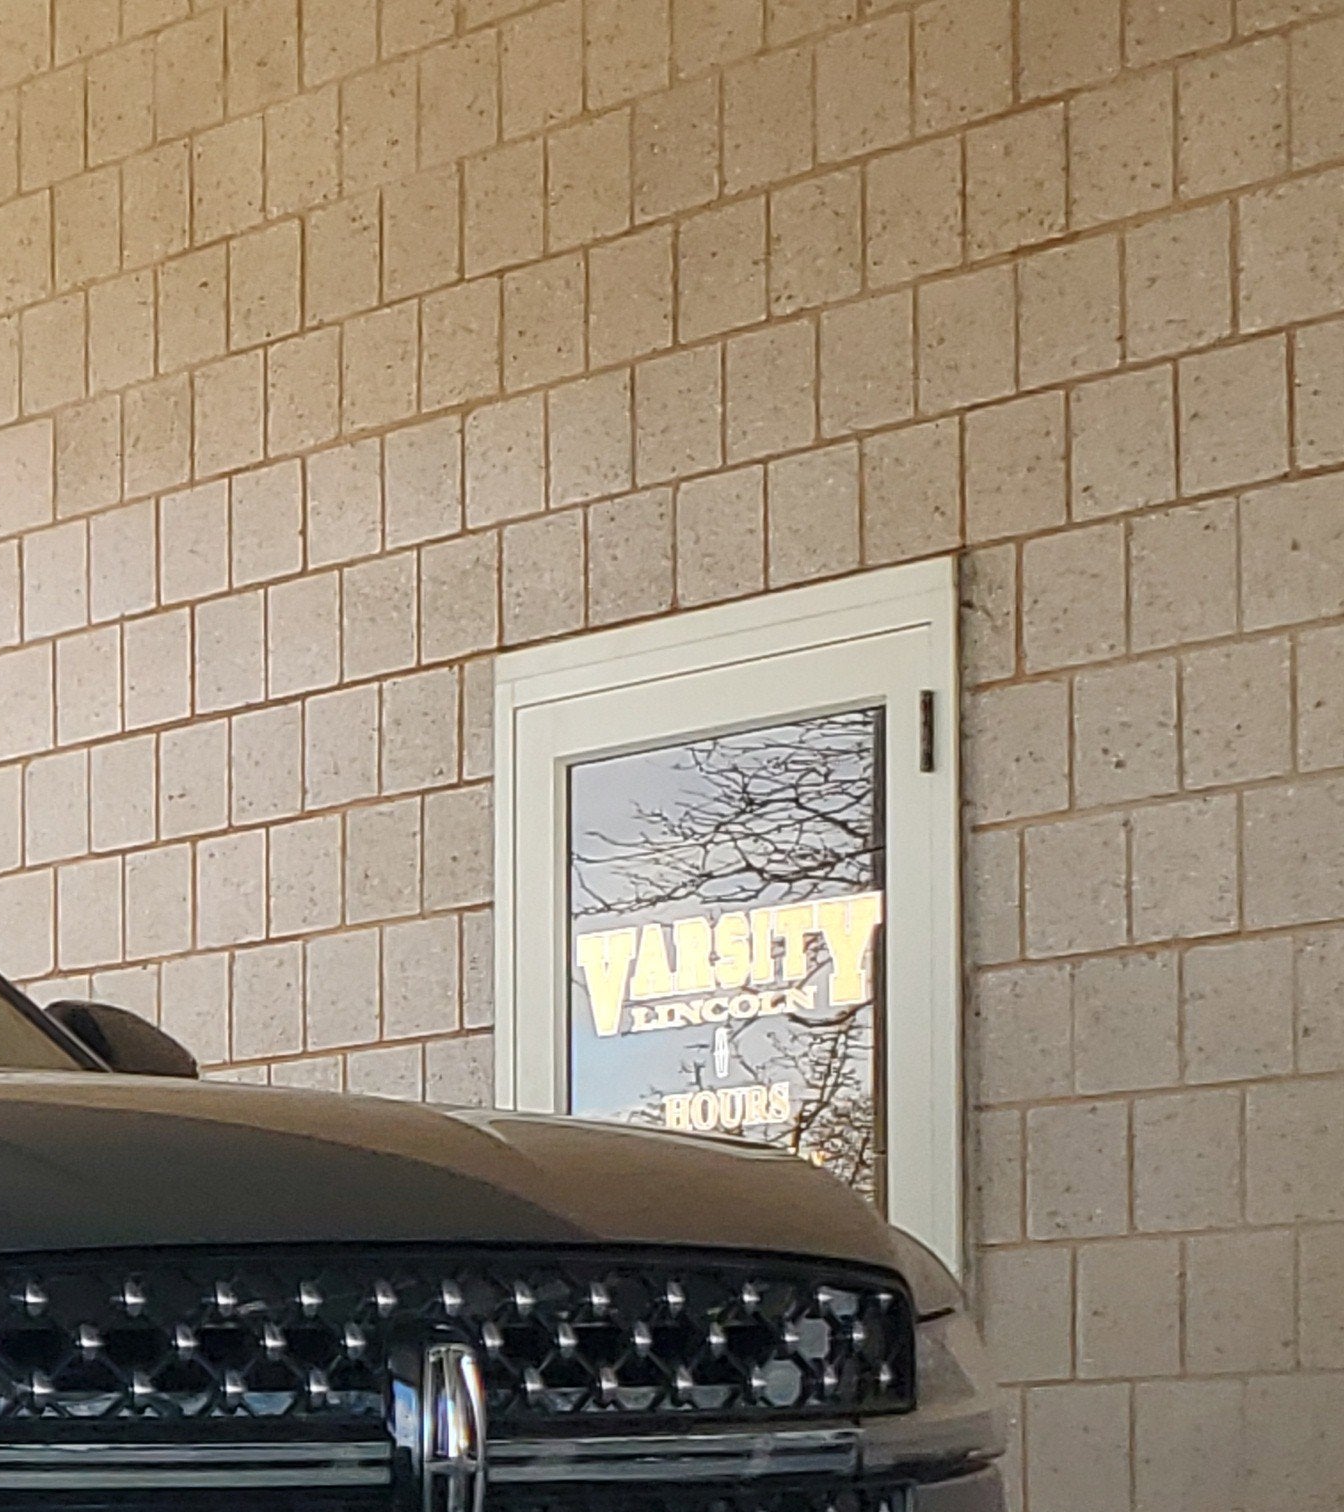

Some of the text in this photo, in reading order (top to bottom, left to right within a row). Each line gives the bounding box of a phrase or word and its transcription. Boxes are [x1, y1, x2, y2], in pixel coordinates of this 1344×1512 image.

[576, 891, 883, 1037] VARSITY
[631, 985, 818, 1032] LINCOLN
[662, 1082, 791, 1131] HOURS
